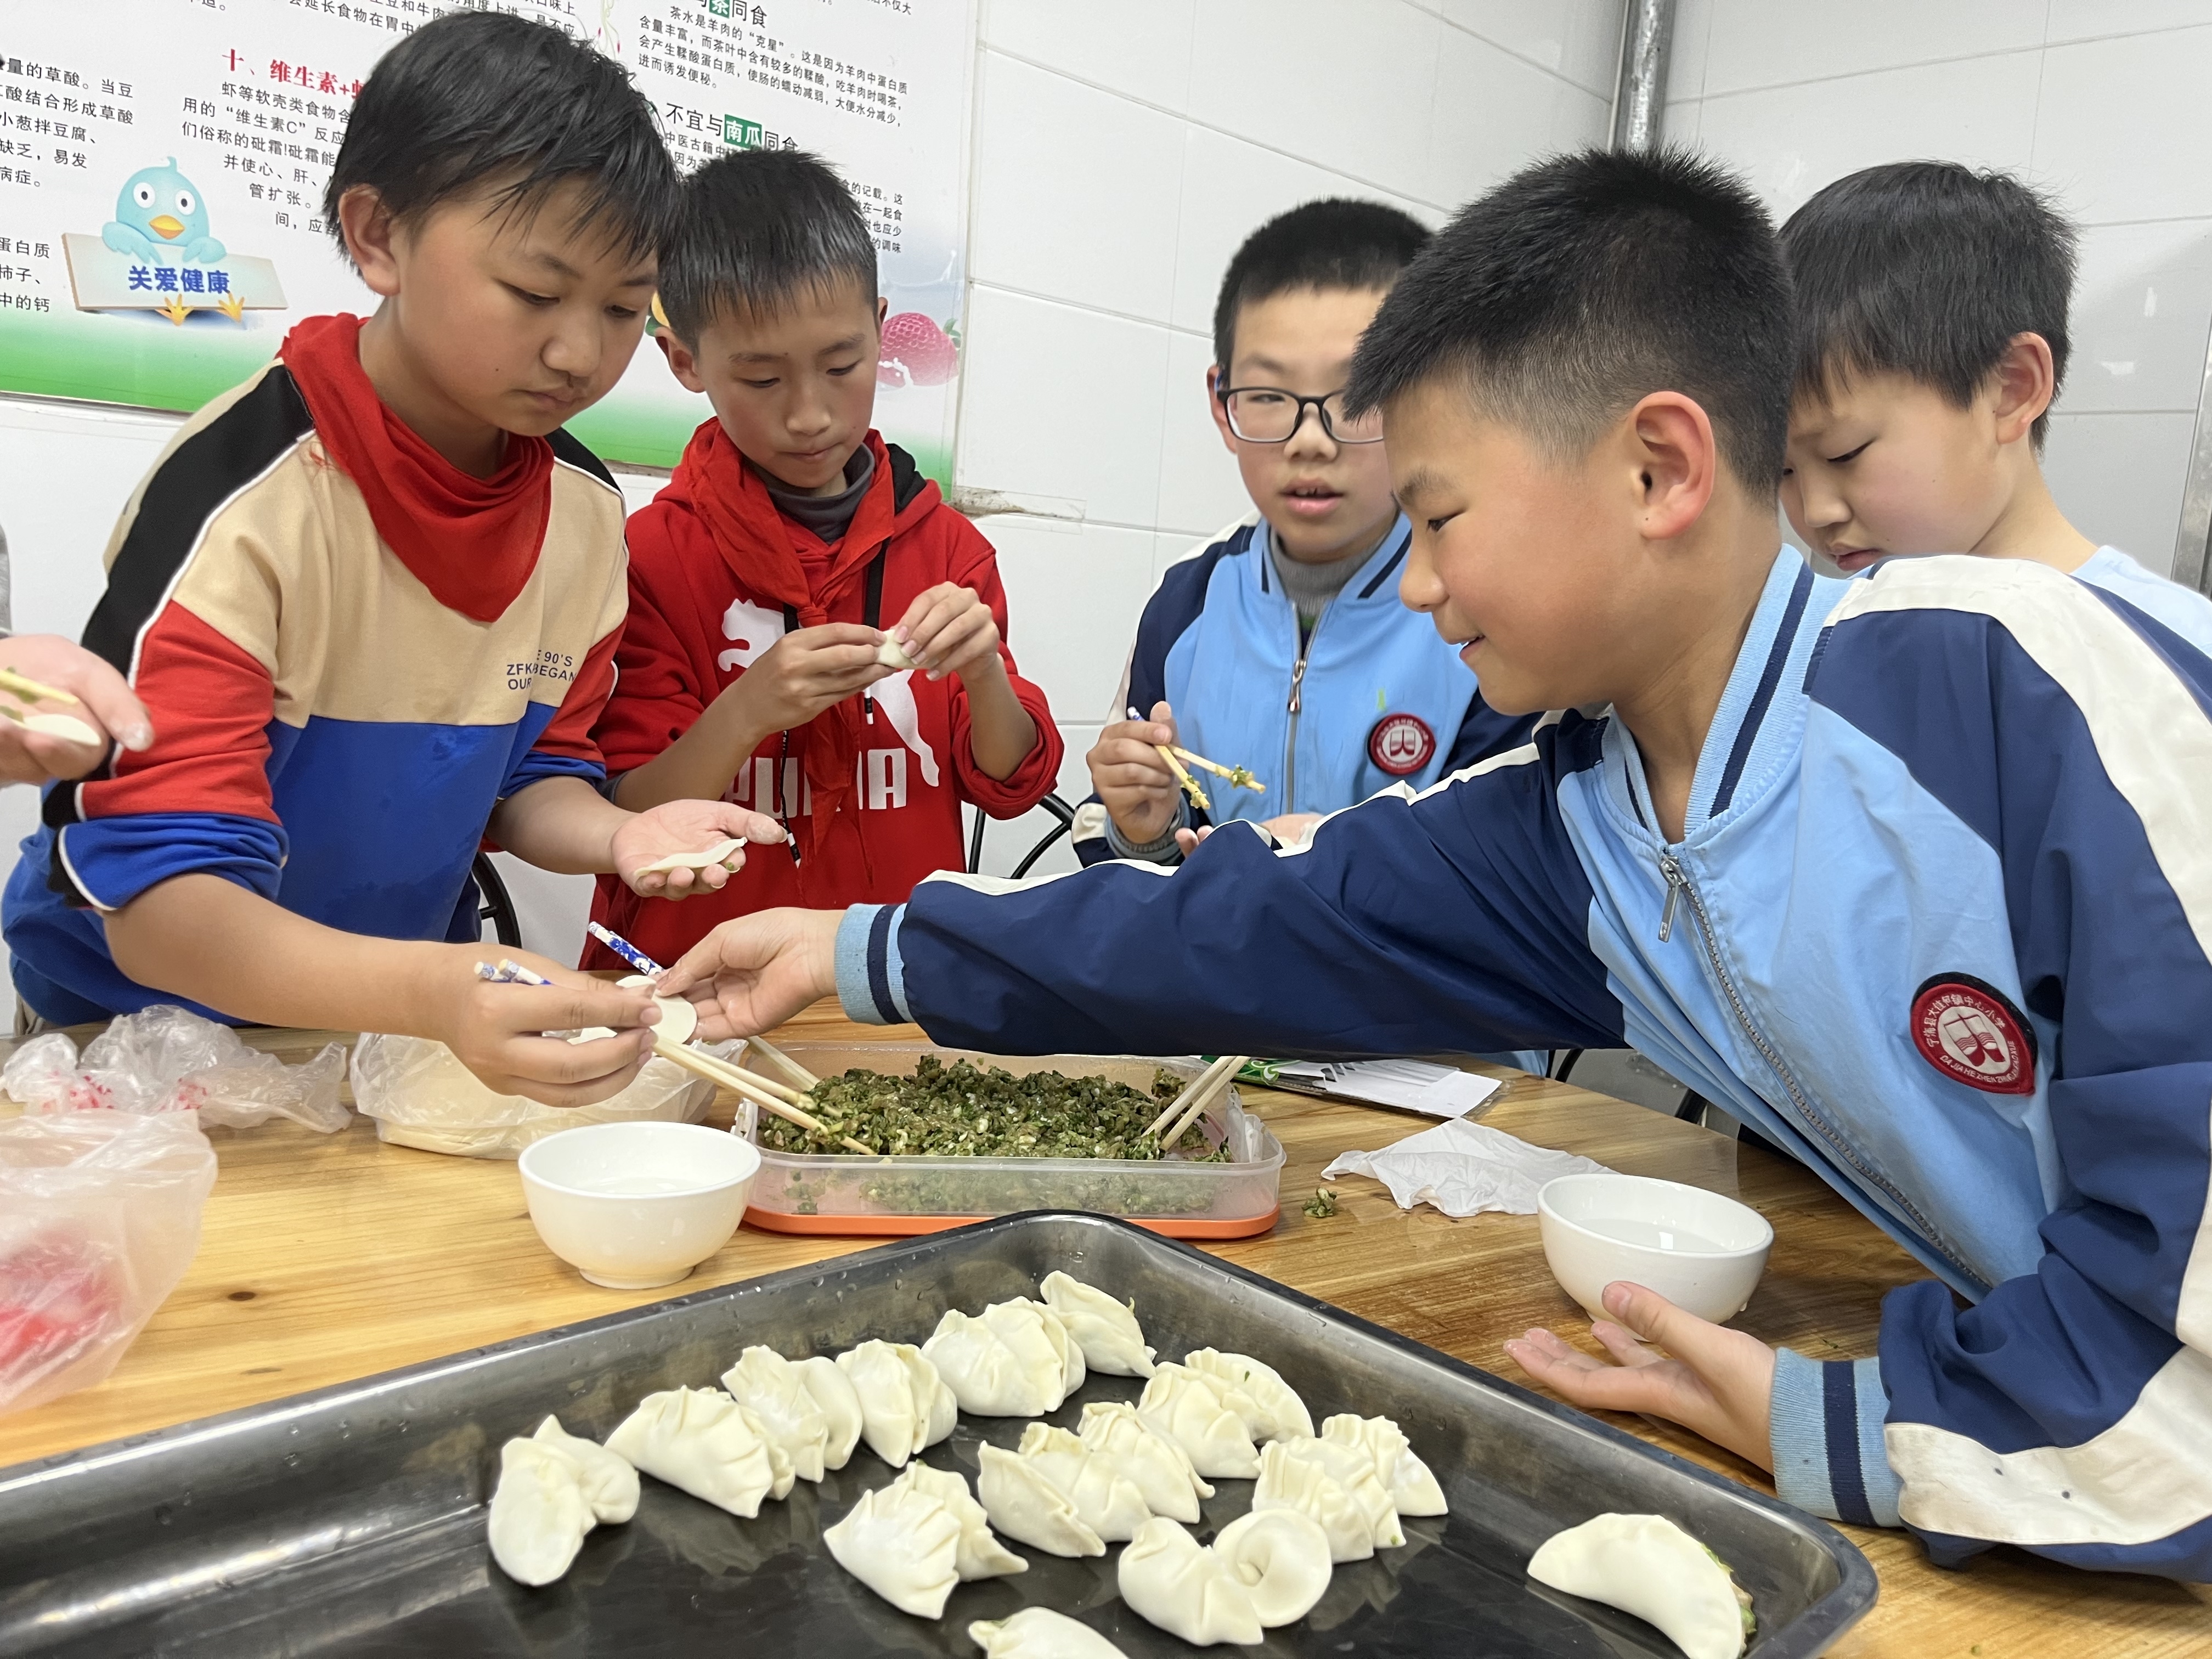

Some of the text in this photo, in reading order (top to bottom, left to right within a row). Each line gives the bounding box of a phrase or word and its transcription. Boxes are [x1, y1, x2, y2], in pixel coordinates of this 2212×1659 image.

[290, 0, 421, 36] 延长食物在胃中
[696, 0, 767, 29] 茶同食
[0, 57, 133, 98] 量的草酸。当豆
[0, 83, 133, 125] 酸结合形成草酸
[250, 183, 311, 208] 管扩张。
[128, 265, 230, 294] 关爱健康
[725, 747, 907, 820] PUA
